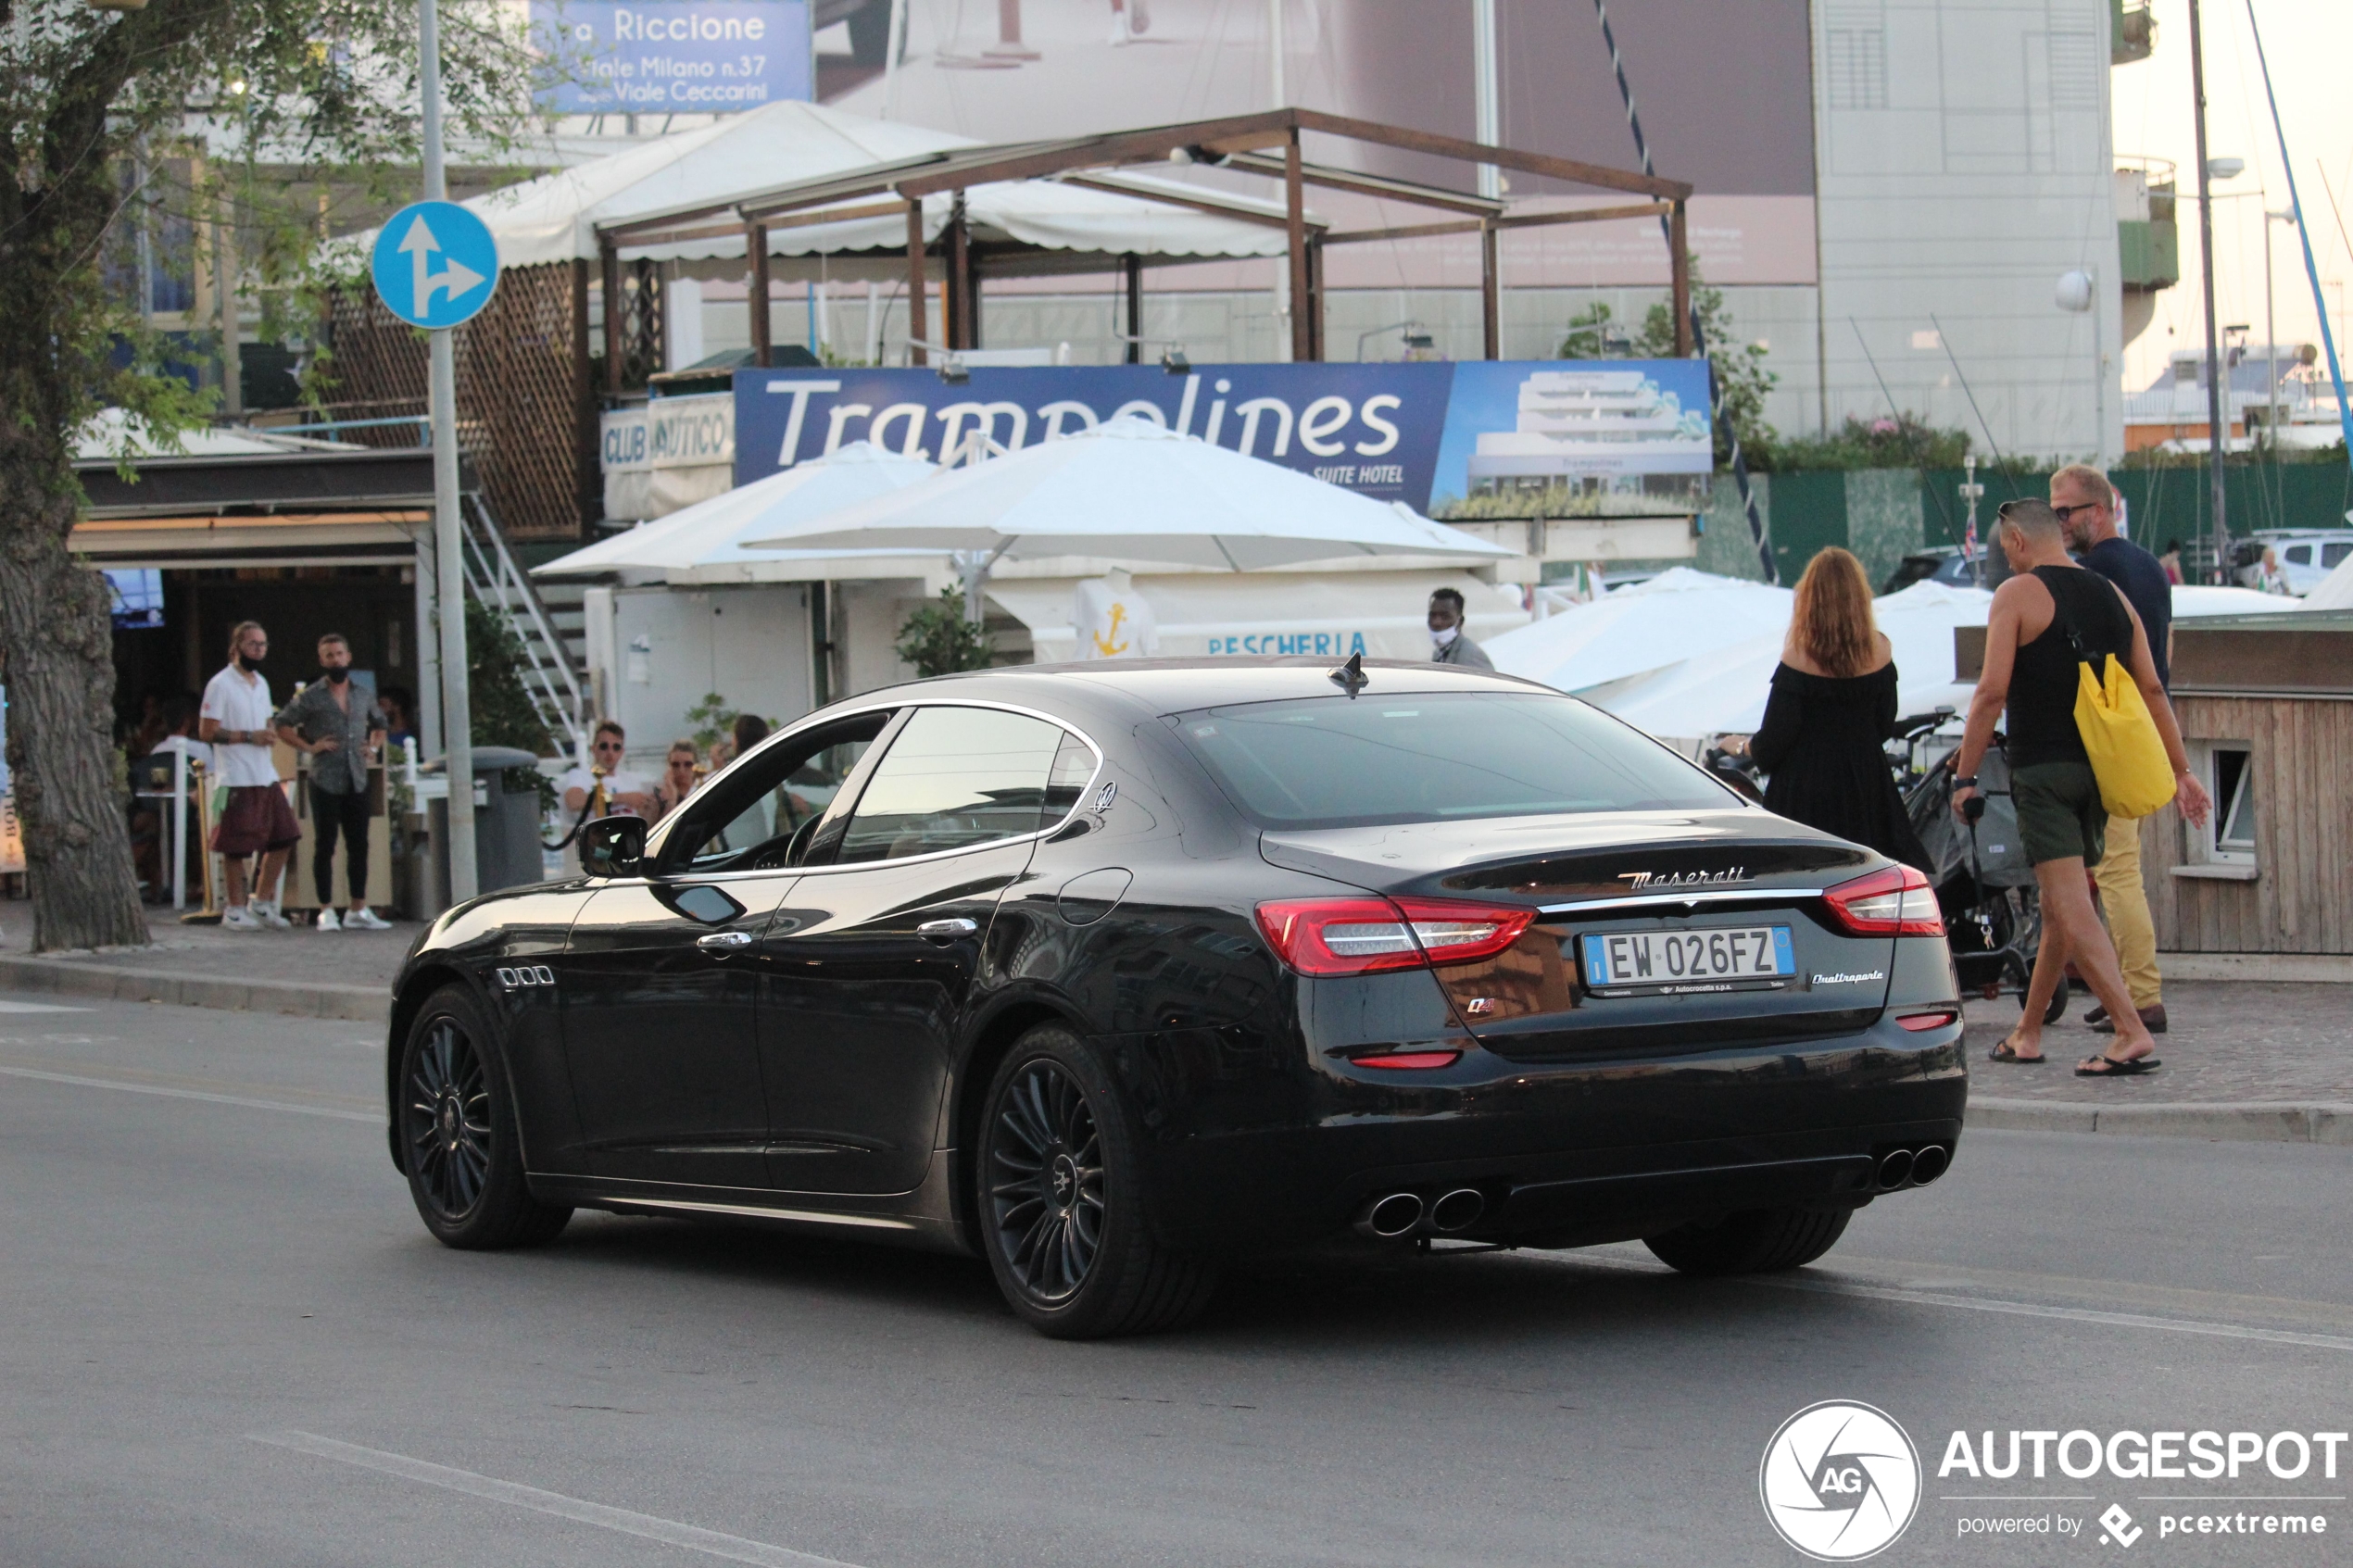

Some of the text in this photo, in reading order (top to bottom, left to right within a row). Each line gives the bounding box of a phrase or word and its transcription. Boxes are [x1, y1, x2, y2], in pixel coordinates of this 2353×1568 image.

[574, 9, 765, 41] a Riccione
[641, 56, 715, 77] Milano
[722, 55, 766, 77] n.37
[614, 82, 666, 102] Viale
[671, 81, 768, 102] Ceccarini
[605, 412, 725, 462] CLUB AUTICO
[1314, 465, 1403, 483] SUITE HOTEL
[1209, 632, 1366, 656] PESCHERIA
[1617, 866, 1755, 890] Maserati
[1609, 935, 1652, 979] EW
[1665, 931, 1772, 976] 026FZ
[1812, 970, 1883, 985] Quattroporte
[1675, 985, 1715, 993] Autocrocetta
[1467, 997, 1495, 1013] Q4
